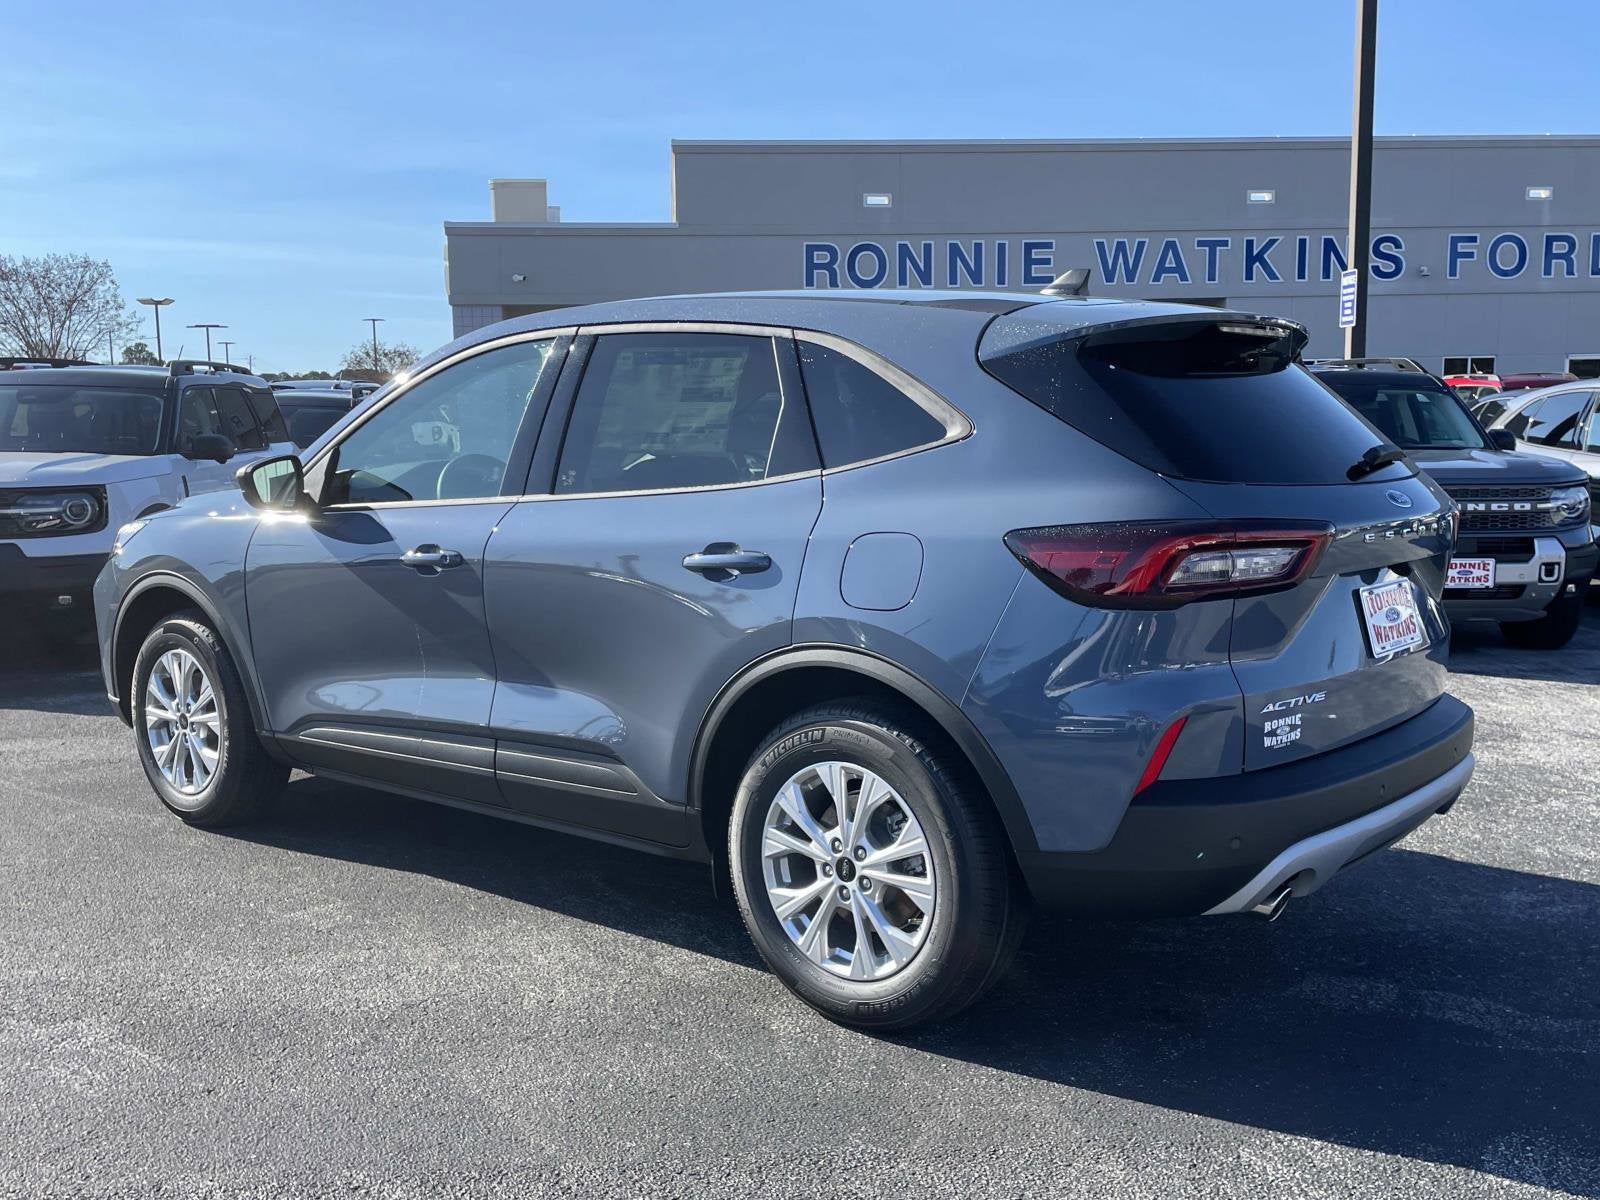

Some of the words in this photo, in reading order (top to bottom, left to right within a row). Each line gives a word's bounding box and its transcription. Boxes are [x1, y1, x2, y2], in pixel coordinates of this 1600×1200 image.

[803, 240, 1056, 289] RONNIE
[1093, 233, 1405, 285] WATKINS
[1457, 503, 1531, 511] NCO
[1372, 614, 1417, 645] WATKINS
[1260, 690, 1328, 714] ACTIVE
[1264, 713, 1302, 734] RONNIE
[764, 728, 824, 767] MICHELIN
[1264, 728, 1302, 748] WATKINS
